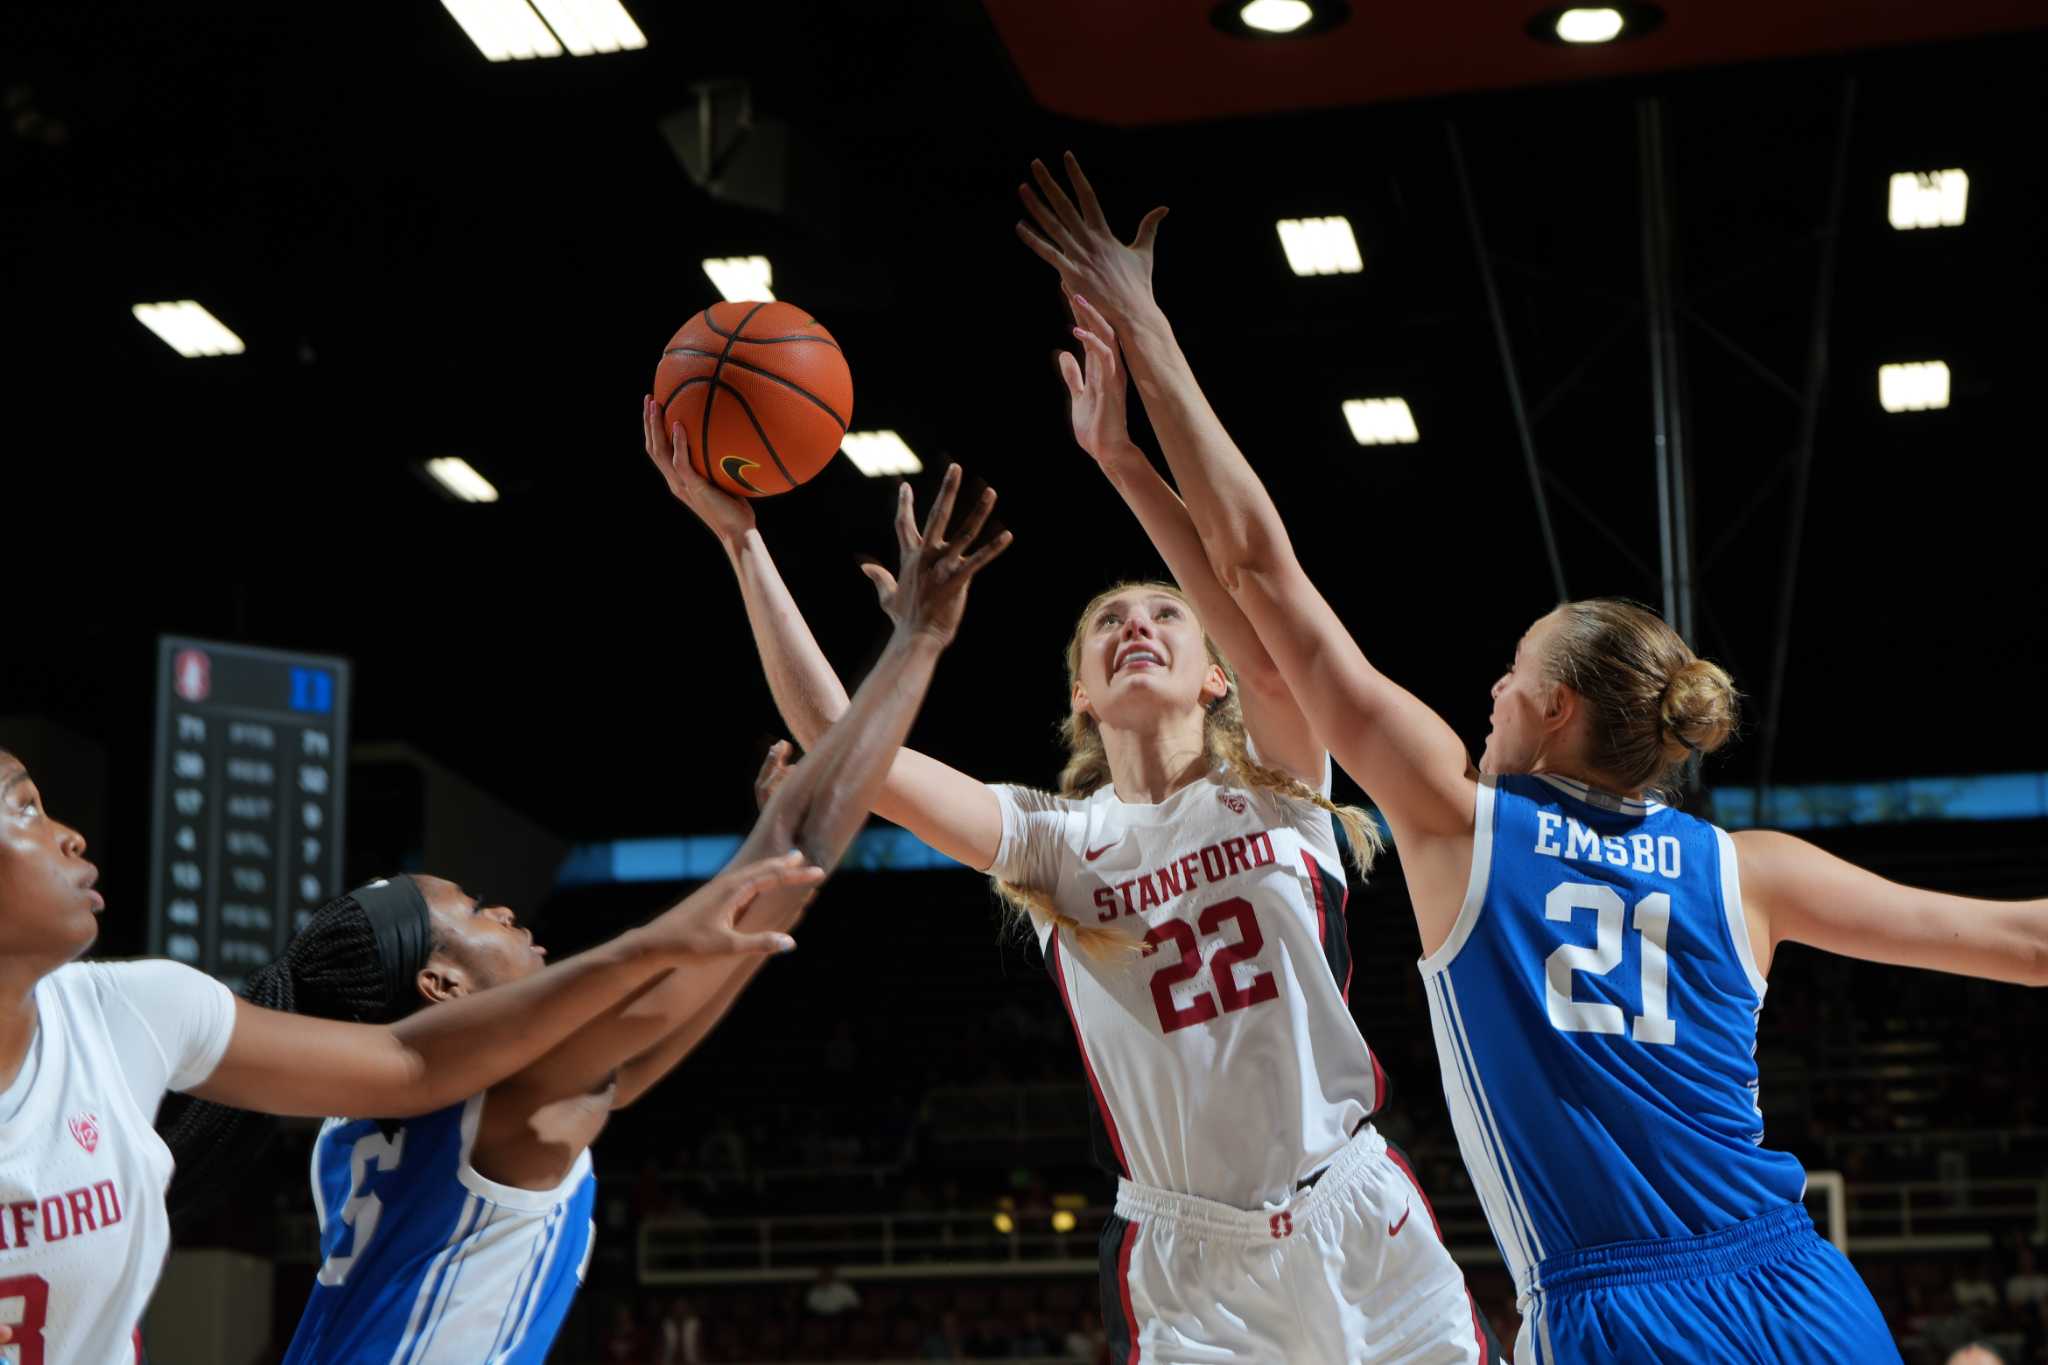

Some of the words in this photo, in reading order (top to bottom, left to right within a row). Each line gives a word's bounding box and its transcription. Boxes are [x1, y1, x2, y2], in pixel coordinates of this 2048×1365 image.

[1093, 830, 1276, 922] STANFORD
[1534, 810, 1681, 879] EMSBO
[1141, 895, 1280, 1034] 22
[1544, 881, 1679, 1045] 21
